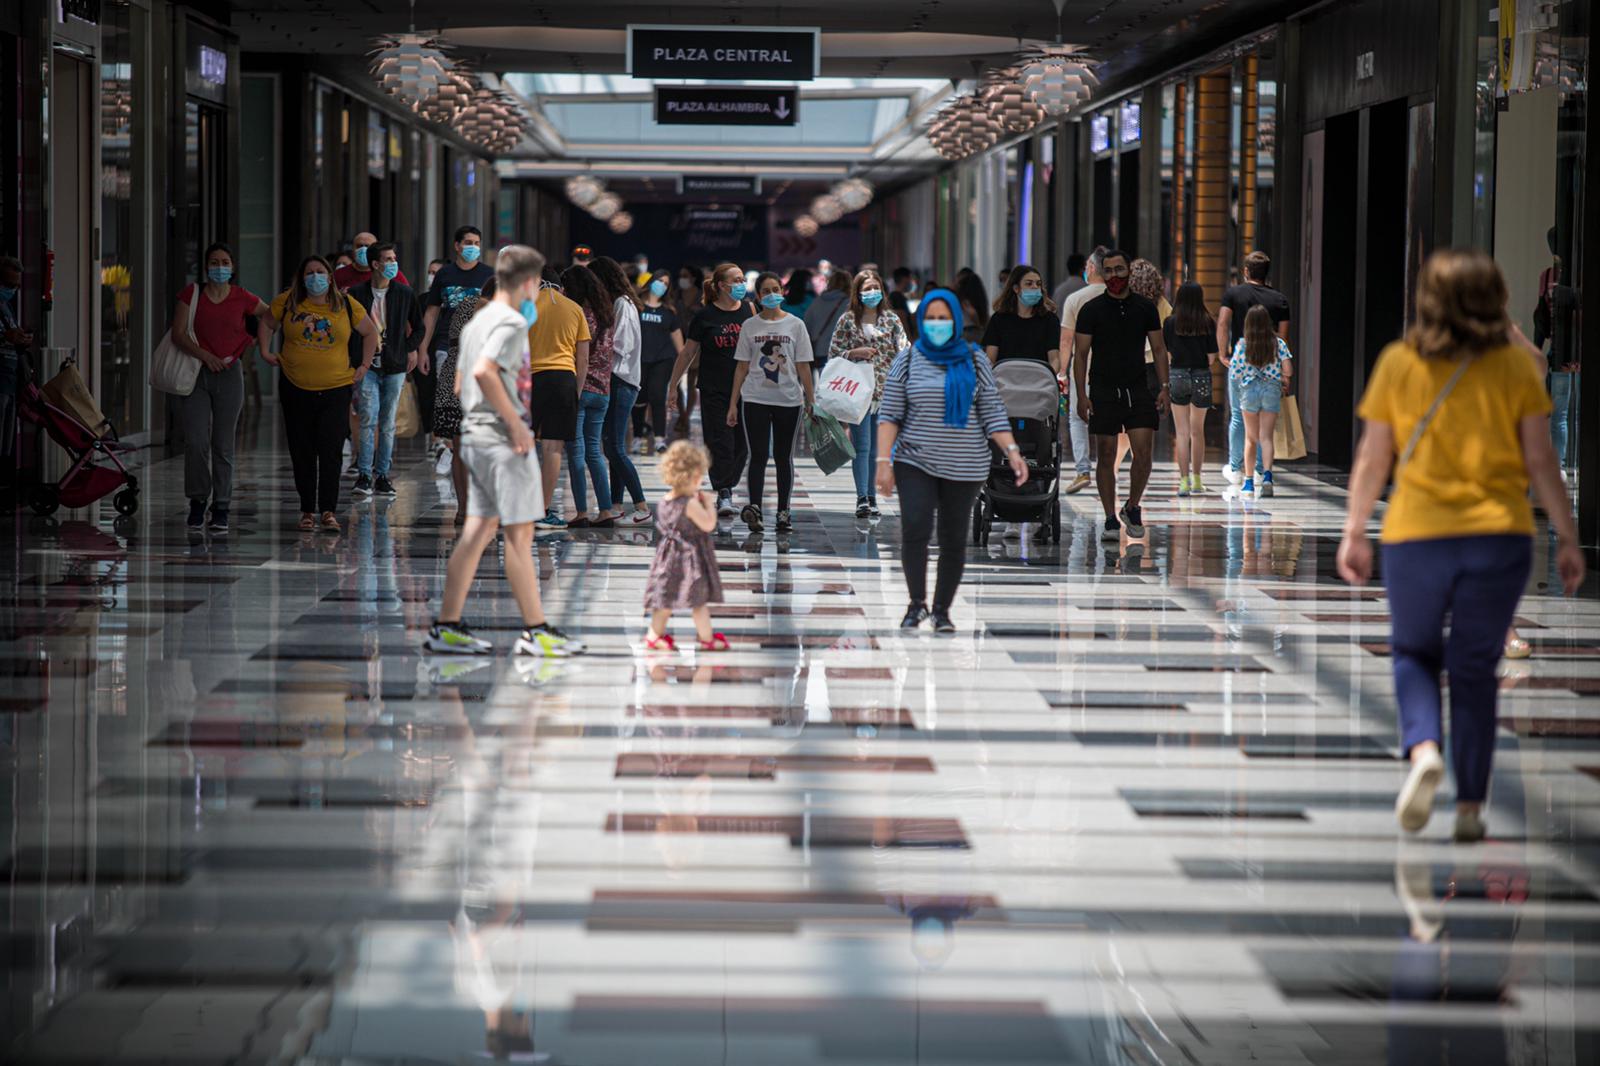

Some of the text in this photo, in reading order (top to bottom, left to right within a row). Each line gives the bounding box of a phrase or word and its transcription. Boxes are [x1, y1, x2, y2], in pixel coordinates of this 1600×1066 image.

[653, 47, 792, 62] PLAZA CENTRAL
[666, 101, 771, 112] PLAZA ALHAMBRA
[827, 375, 860, 397] H&M
